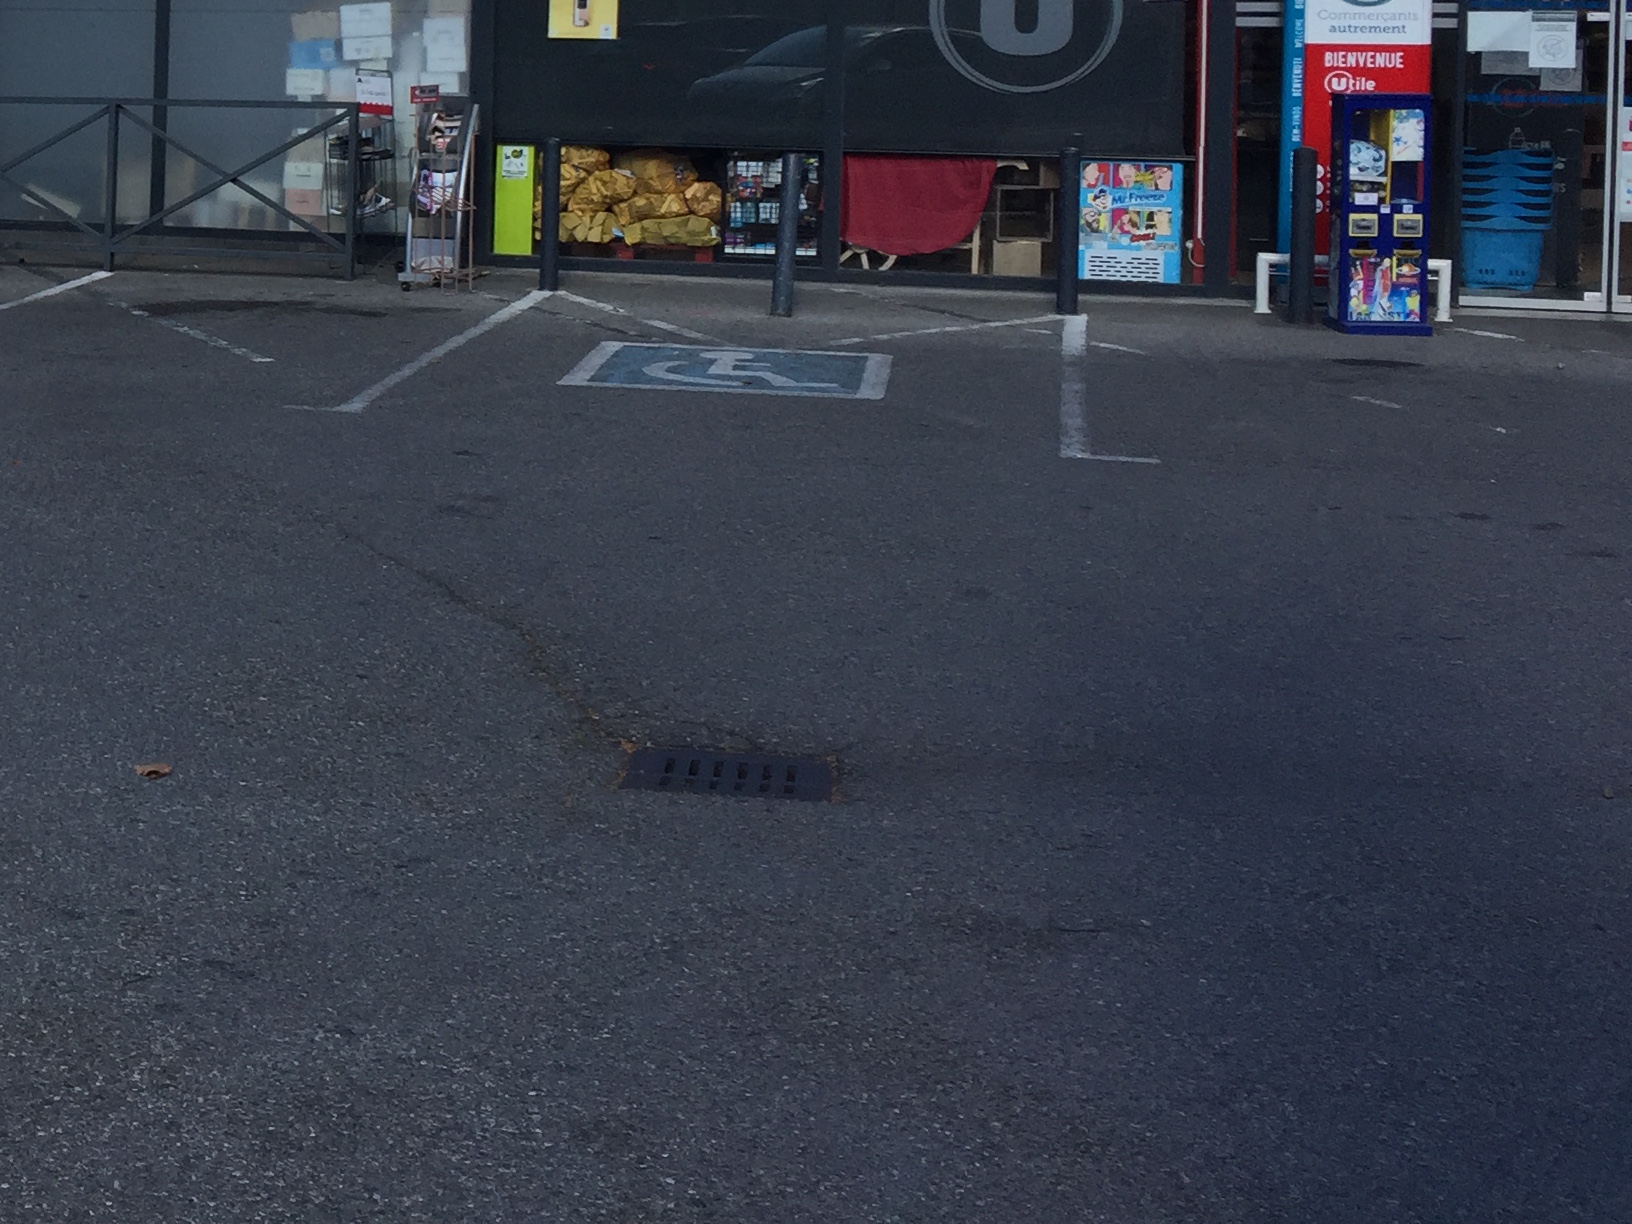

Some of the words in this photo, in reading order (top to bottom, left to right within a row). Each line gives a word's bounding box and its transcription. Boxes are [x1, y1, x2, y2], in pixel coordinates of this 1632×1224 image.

[1317, 9, 1419, 23] Commerçants
[1329, 24, 1407, 35] autrement
[1324, 51, 1405, 69] BIENVENUE
[1329, 75, 1377, 92] Utile
